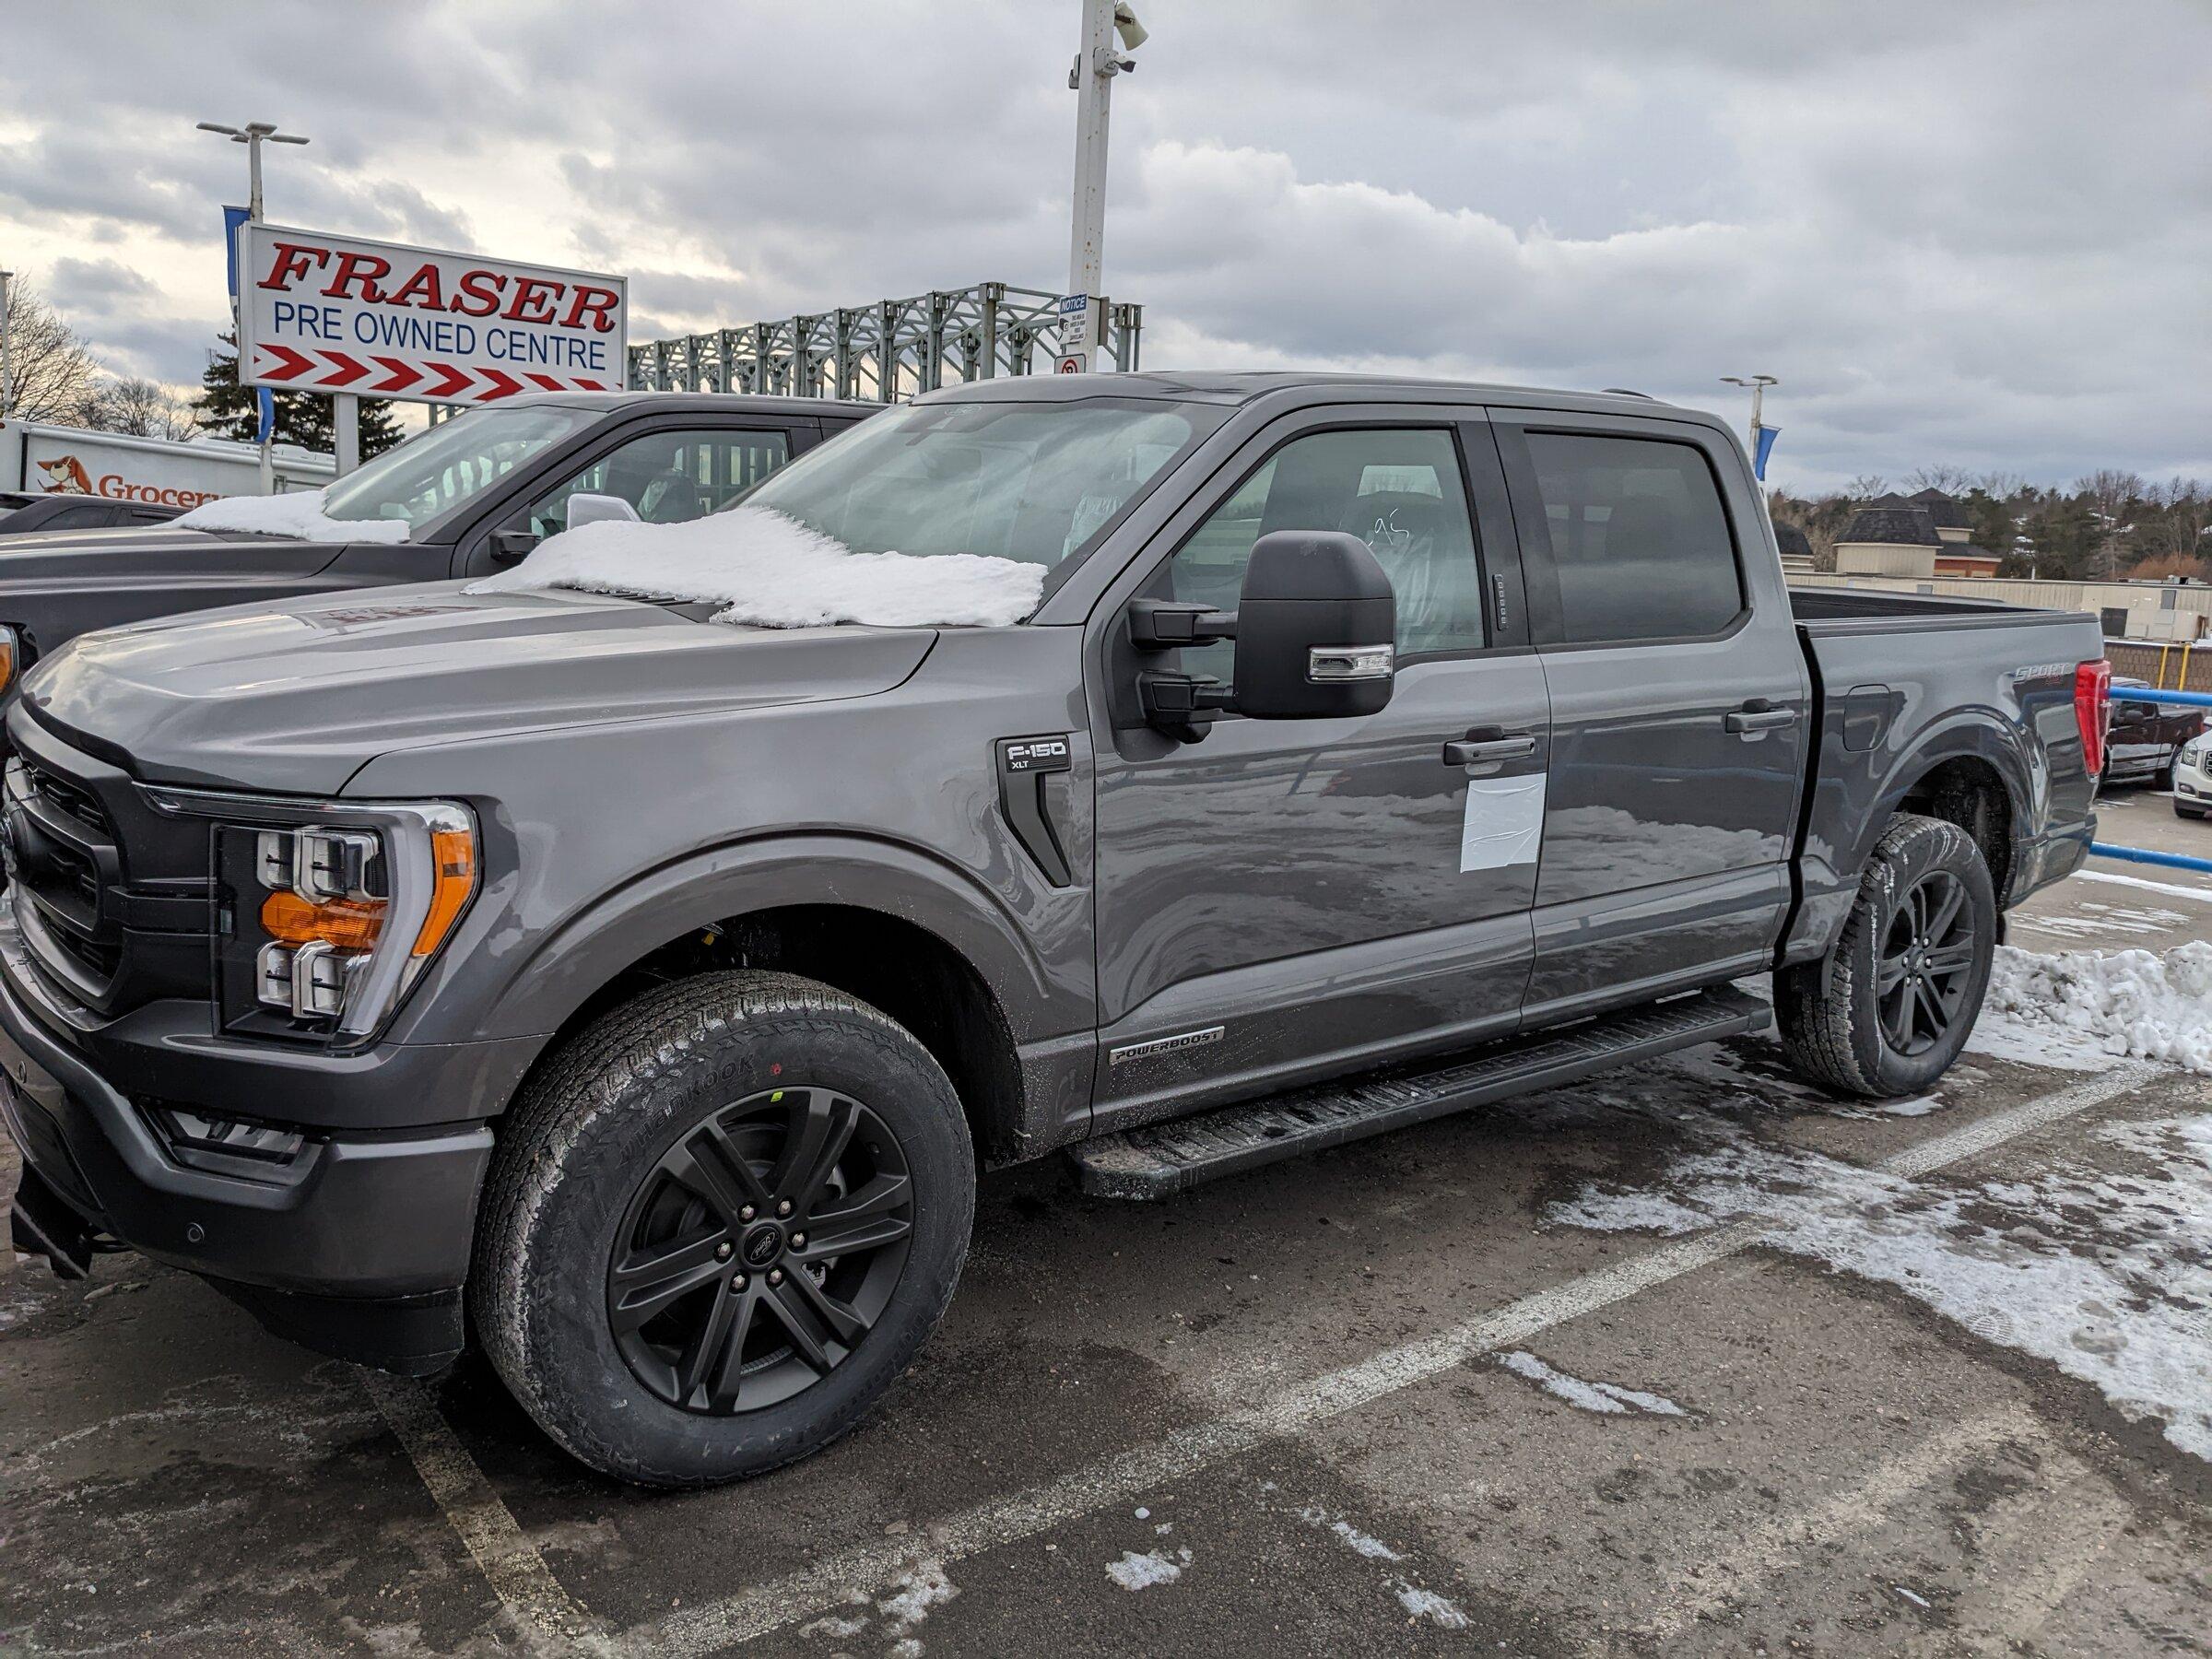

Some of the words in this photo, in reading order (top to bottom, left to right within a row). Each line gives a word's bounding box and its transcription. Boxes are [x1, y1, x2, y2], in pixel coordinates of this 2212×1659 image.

[255, 242, 620, 334] FRASER
[1061, 296, 1086, 312] NOTICE
[274, 300, 344, 341] PRE
[354, 312, 477, 355] OWNED
[486, 328, 606, 371] CENTRE
[98, 474, 231, 509] Grocer
[2013, 663, 2068, 685] SPORT
[1006, 741, 1067, 760] F-150
[1011, 760, 1030, 770] XLT
[1114, 1030, 1220, 1060] POWERBOOST
